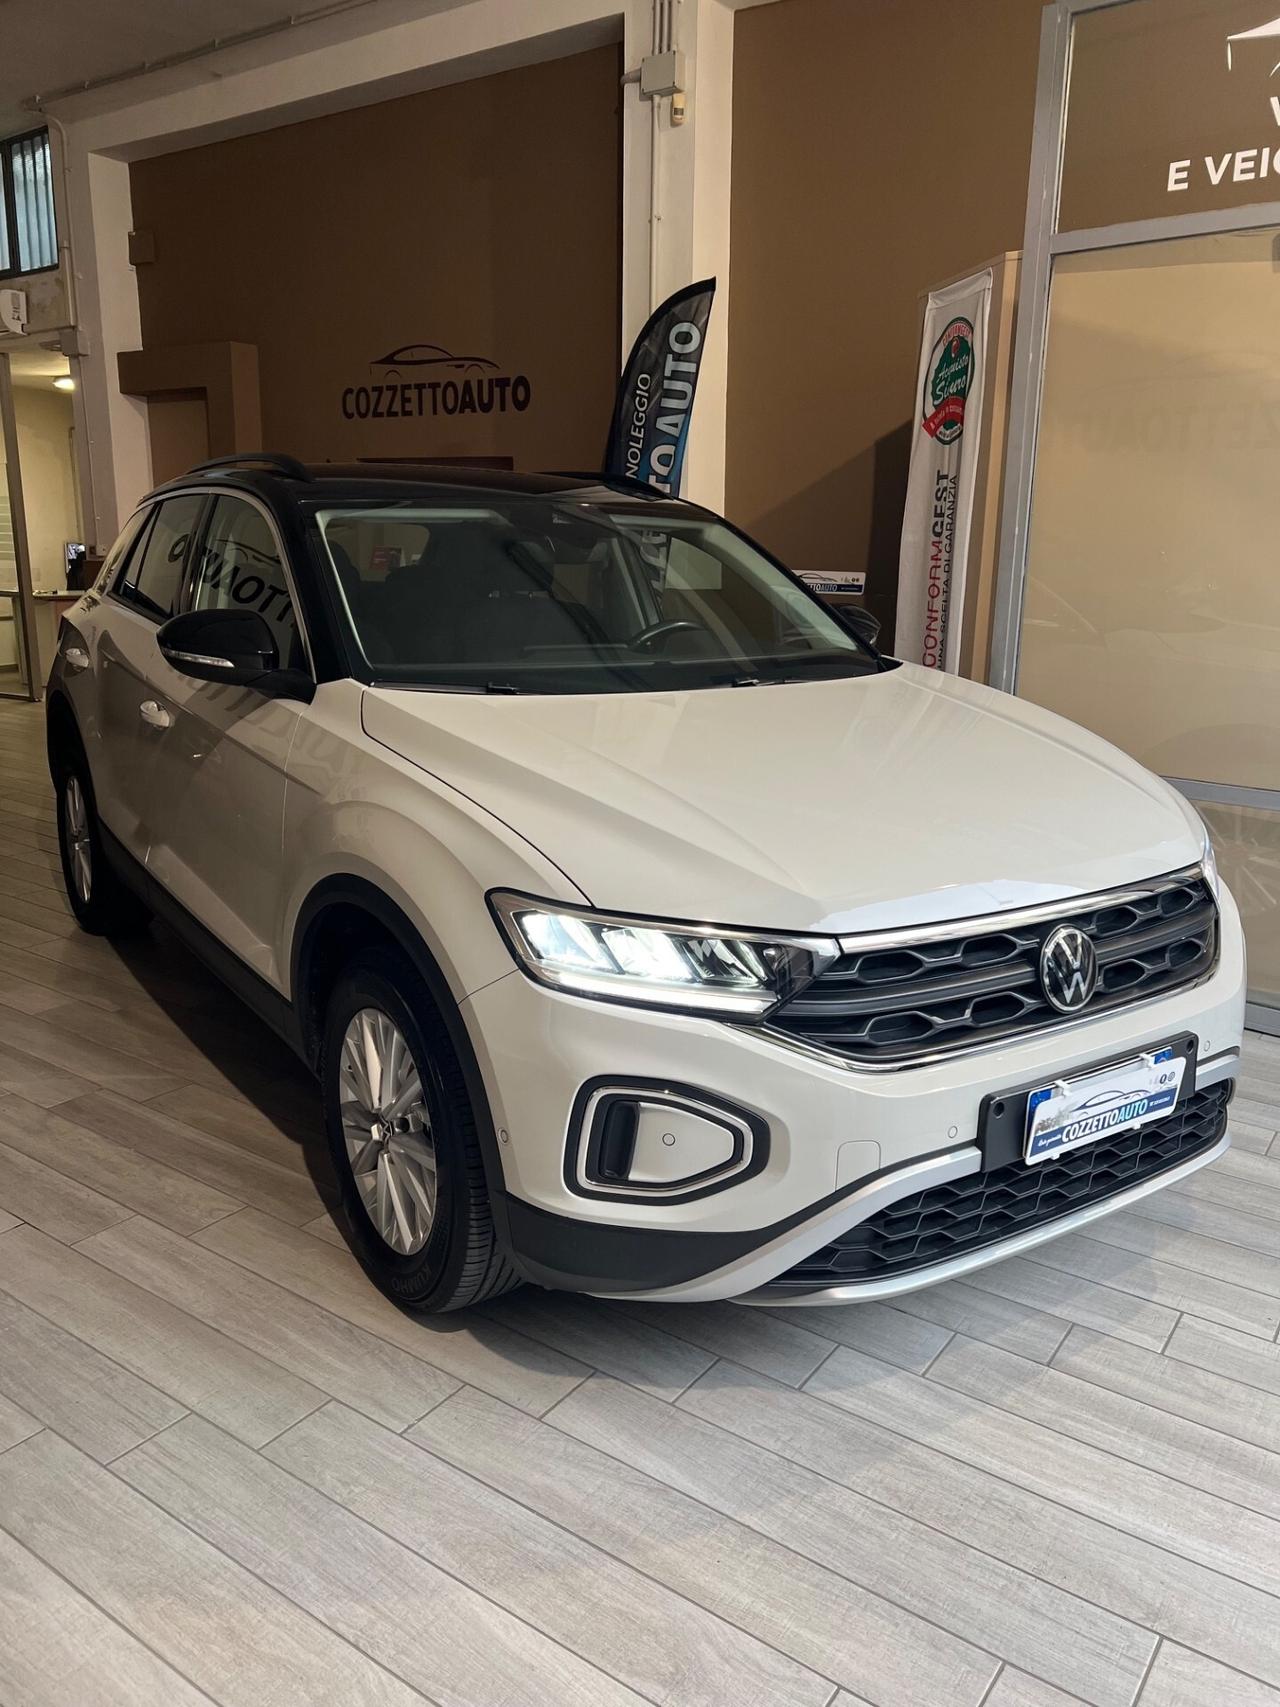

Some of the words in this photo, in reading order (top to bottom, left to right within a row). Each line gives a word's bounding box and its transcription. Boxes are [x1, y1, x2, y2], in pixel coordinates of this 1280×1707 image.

[1167, 159, 1191, 192] E
[342, 375, 531, 420] COZZETTOAUTO
[625, 373, 651, 479] NOLEGGIO
[944, 474, 958, 554] GARANZIA
[922, 470, 949, 668] CONFORMGEST
[943, 557, 952, 574] DI
[1061, 1098, 1149, 1143] COZZETTOAUTO
